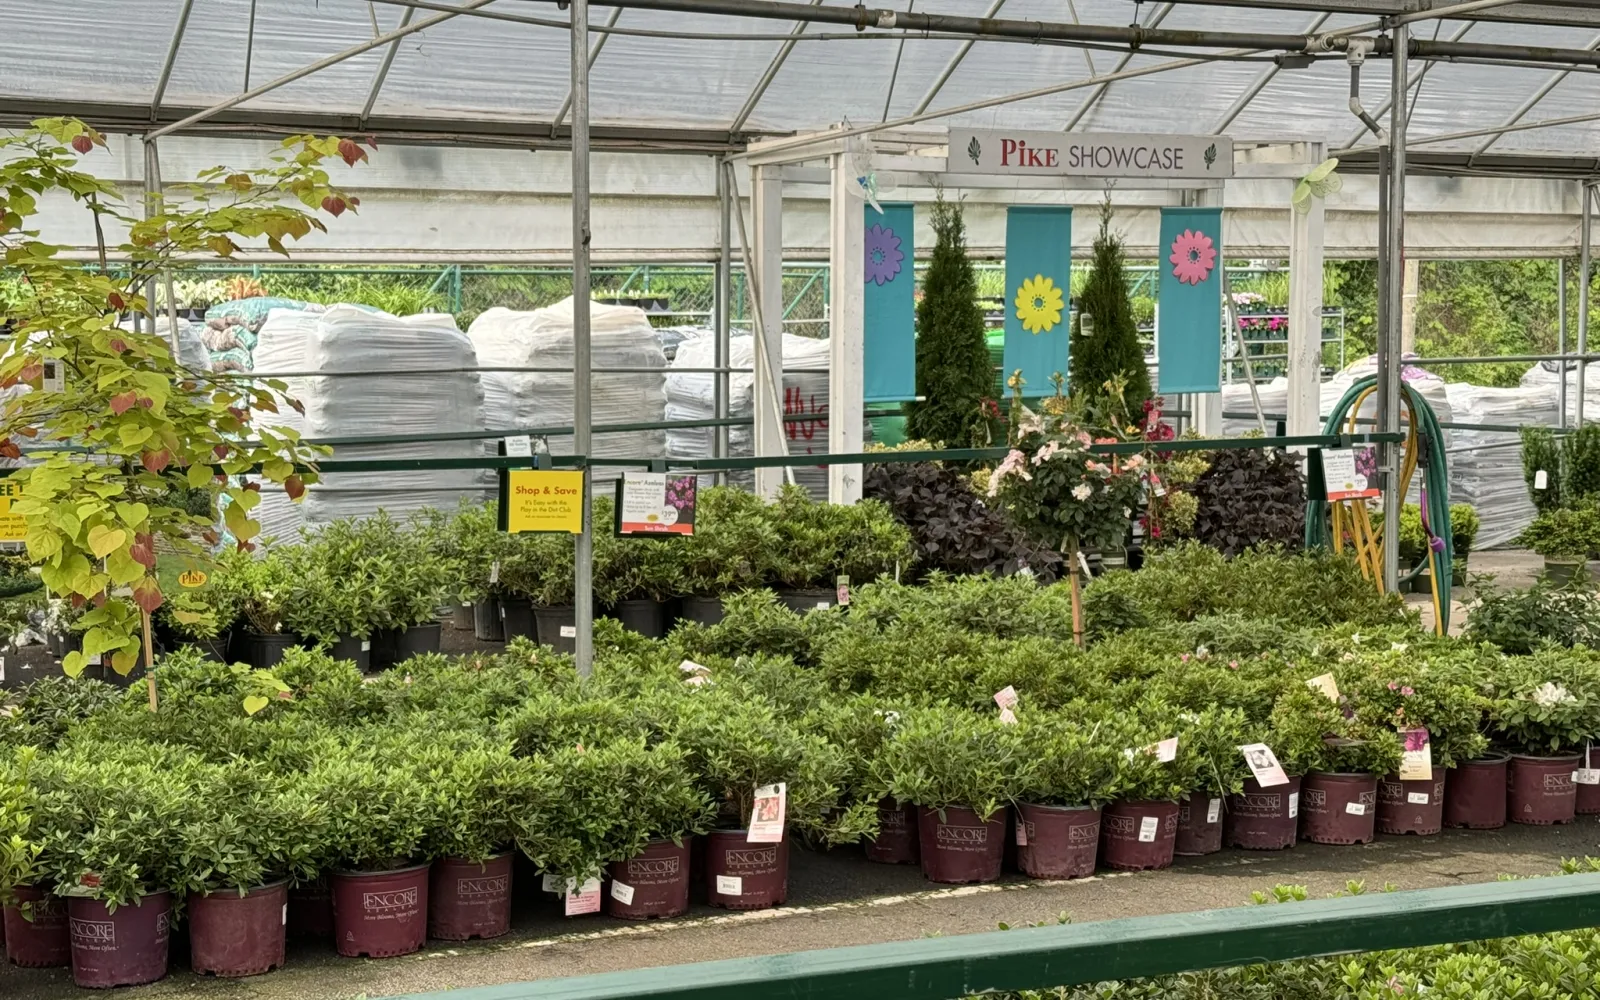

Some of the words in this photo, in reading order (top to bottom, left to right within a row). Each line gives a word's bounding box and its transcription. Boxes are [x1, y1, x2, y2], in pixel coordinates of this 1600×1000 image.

[1068, 144, 1184, 170] SHOWCASE
[515, 485, 540, 496] Shop
[543, 486, 551, 495] &
[554, 486, 578, 495] Save
[520, 506, 532, 514] Play
[533, 499, 546, 507] Easy
[939, 826, 986, 842] ENCORE
[727, 847, 776, 864] ENCORE
[630, 859, 679, 873] ENCORE
[365, 888, 418, 908] ENCORE
